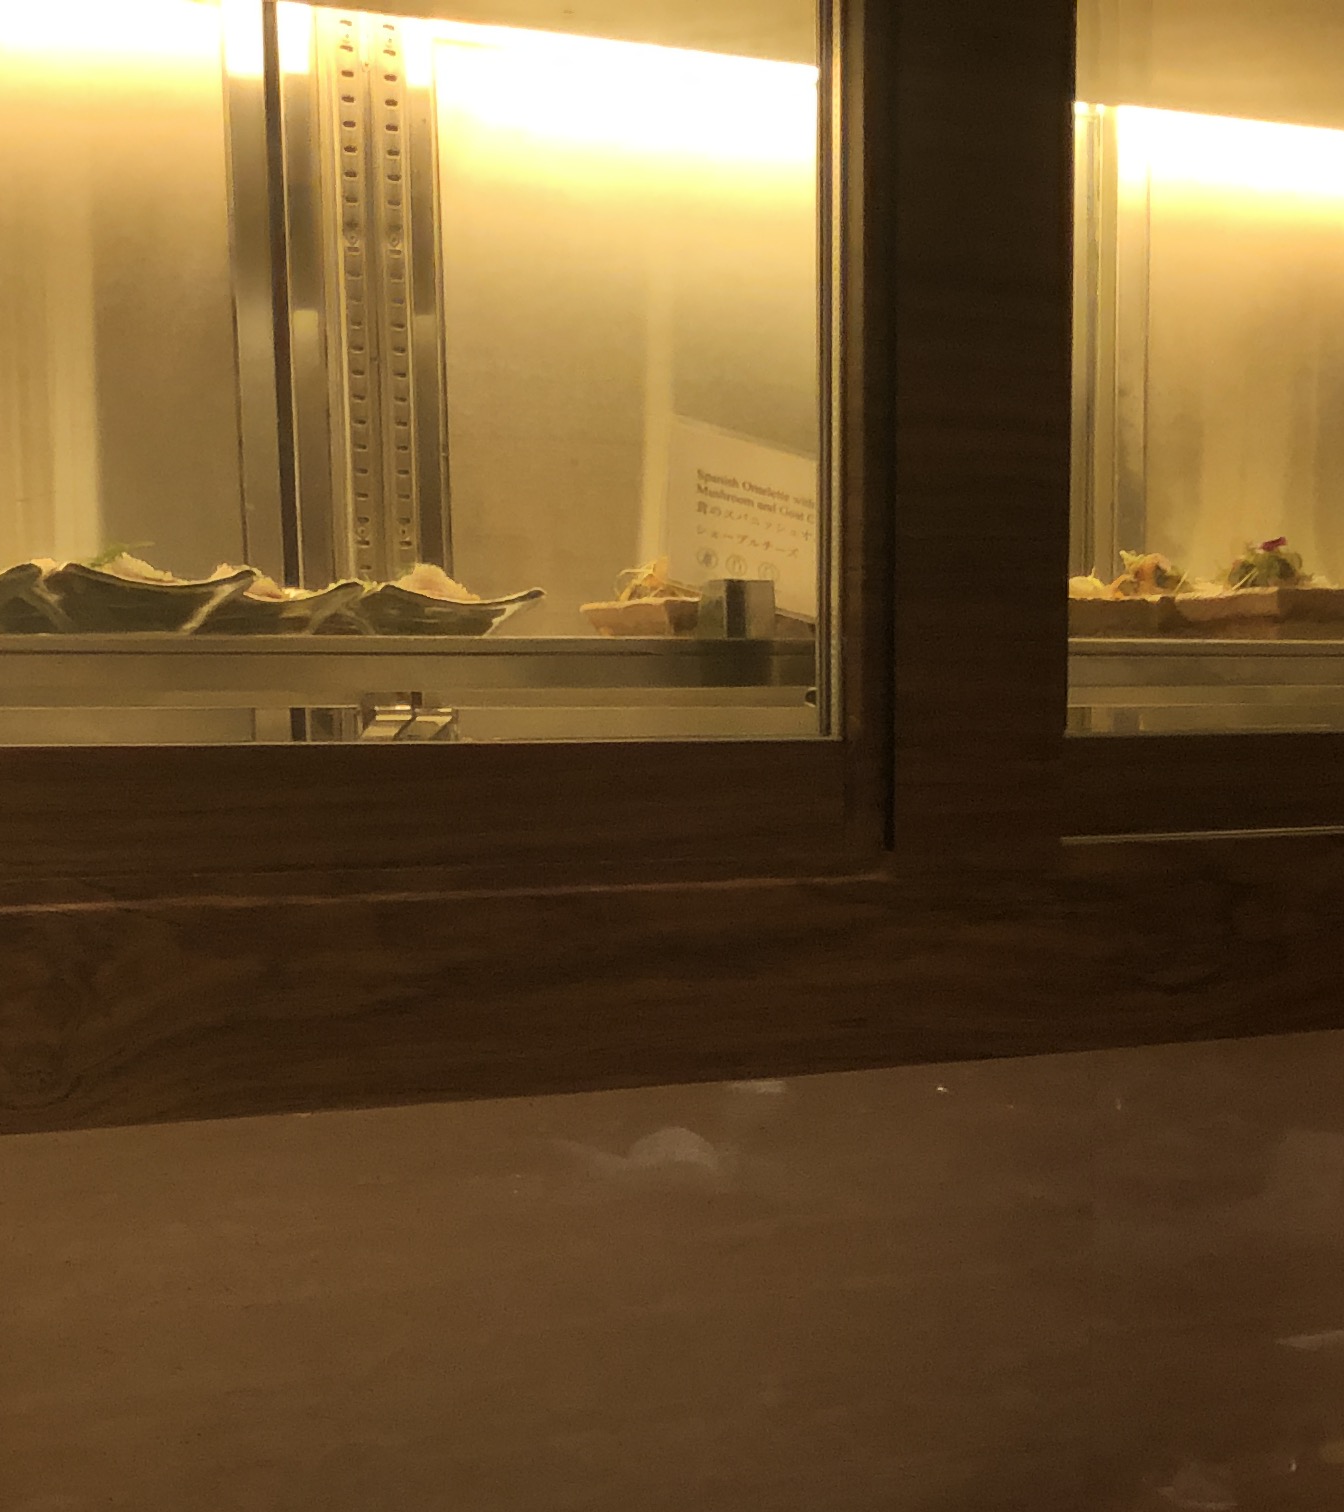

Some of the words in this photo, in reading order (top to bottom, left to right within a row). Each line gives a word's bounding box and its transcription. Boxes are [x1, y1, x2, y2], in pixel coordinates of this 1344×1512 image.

[697, 468, 739, 488] Spanish
[742, 480, 790, 501] Omelette
[697, 483, 754, 507] Mushroom
[757, 502, 776, 512] and
